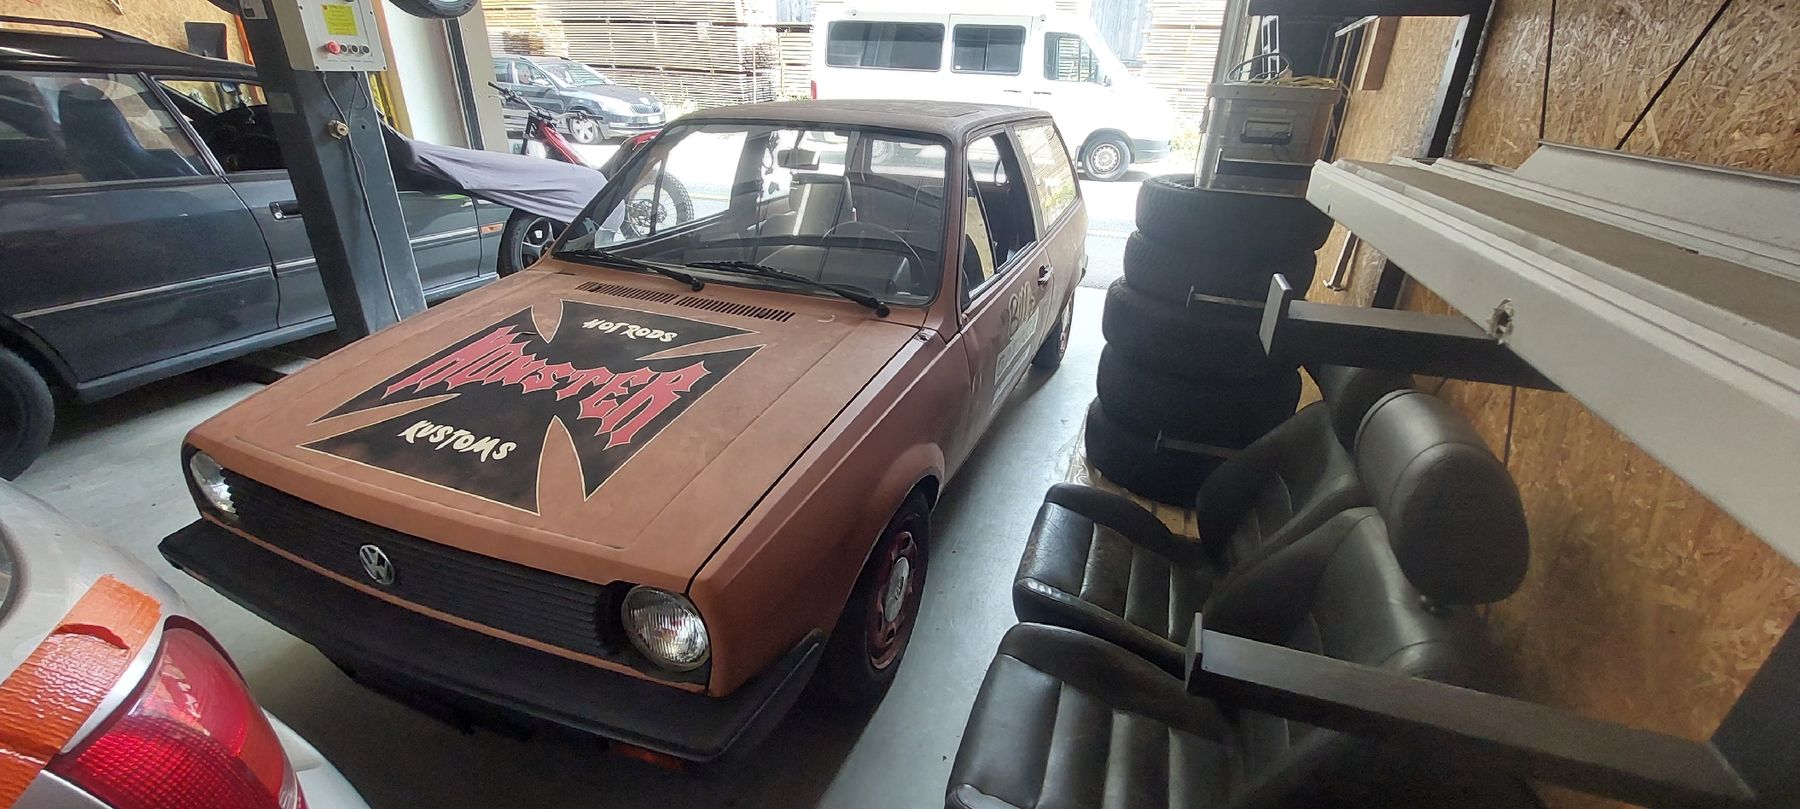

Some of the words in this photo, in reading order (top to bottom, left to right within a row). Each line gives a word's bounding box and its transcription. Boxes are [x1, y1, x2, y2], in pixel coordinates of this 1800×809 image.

[582, 318, 628, 334] HOT
[620, 324, 678, 343] RODS
[381, 324, 712, 451] MONSTER
[397, 420, 517, 462] KUSTOMS
